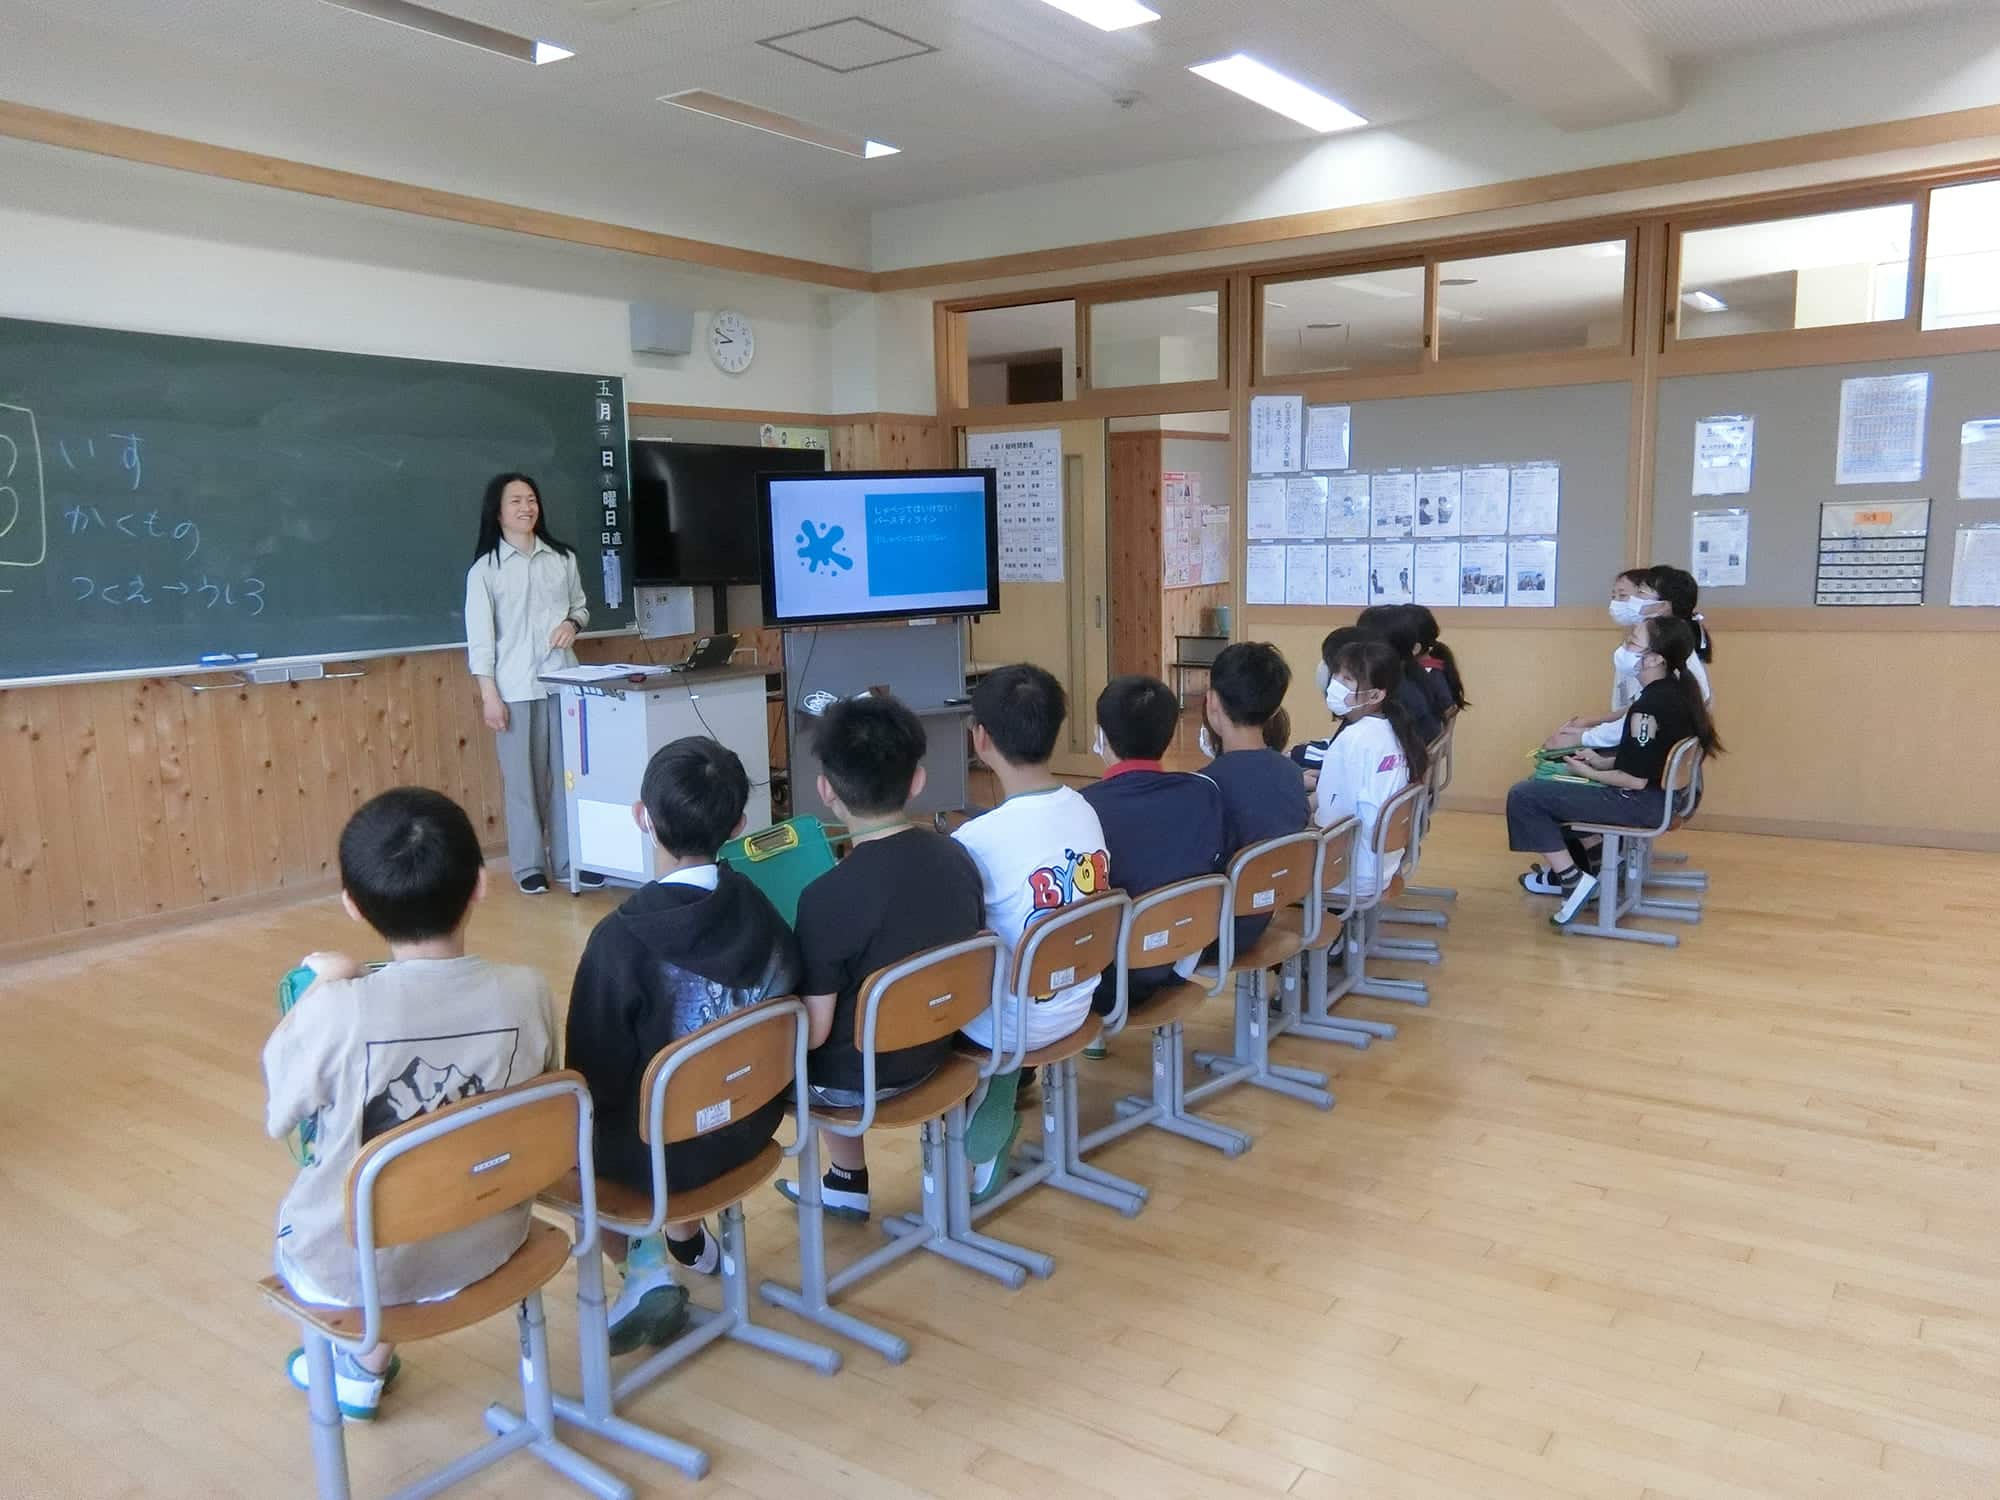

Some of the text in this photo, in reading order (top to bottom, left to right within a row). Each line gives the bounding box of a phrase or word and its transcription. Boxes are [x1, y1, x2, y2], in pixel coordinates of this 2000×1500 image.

[60, 433, 144, 490] いす
[64, 505, 200, 560] かくもの
[72, 575, 265, 616] つくえ うしろ
